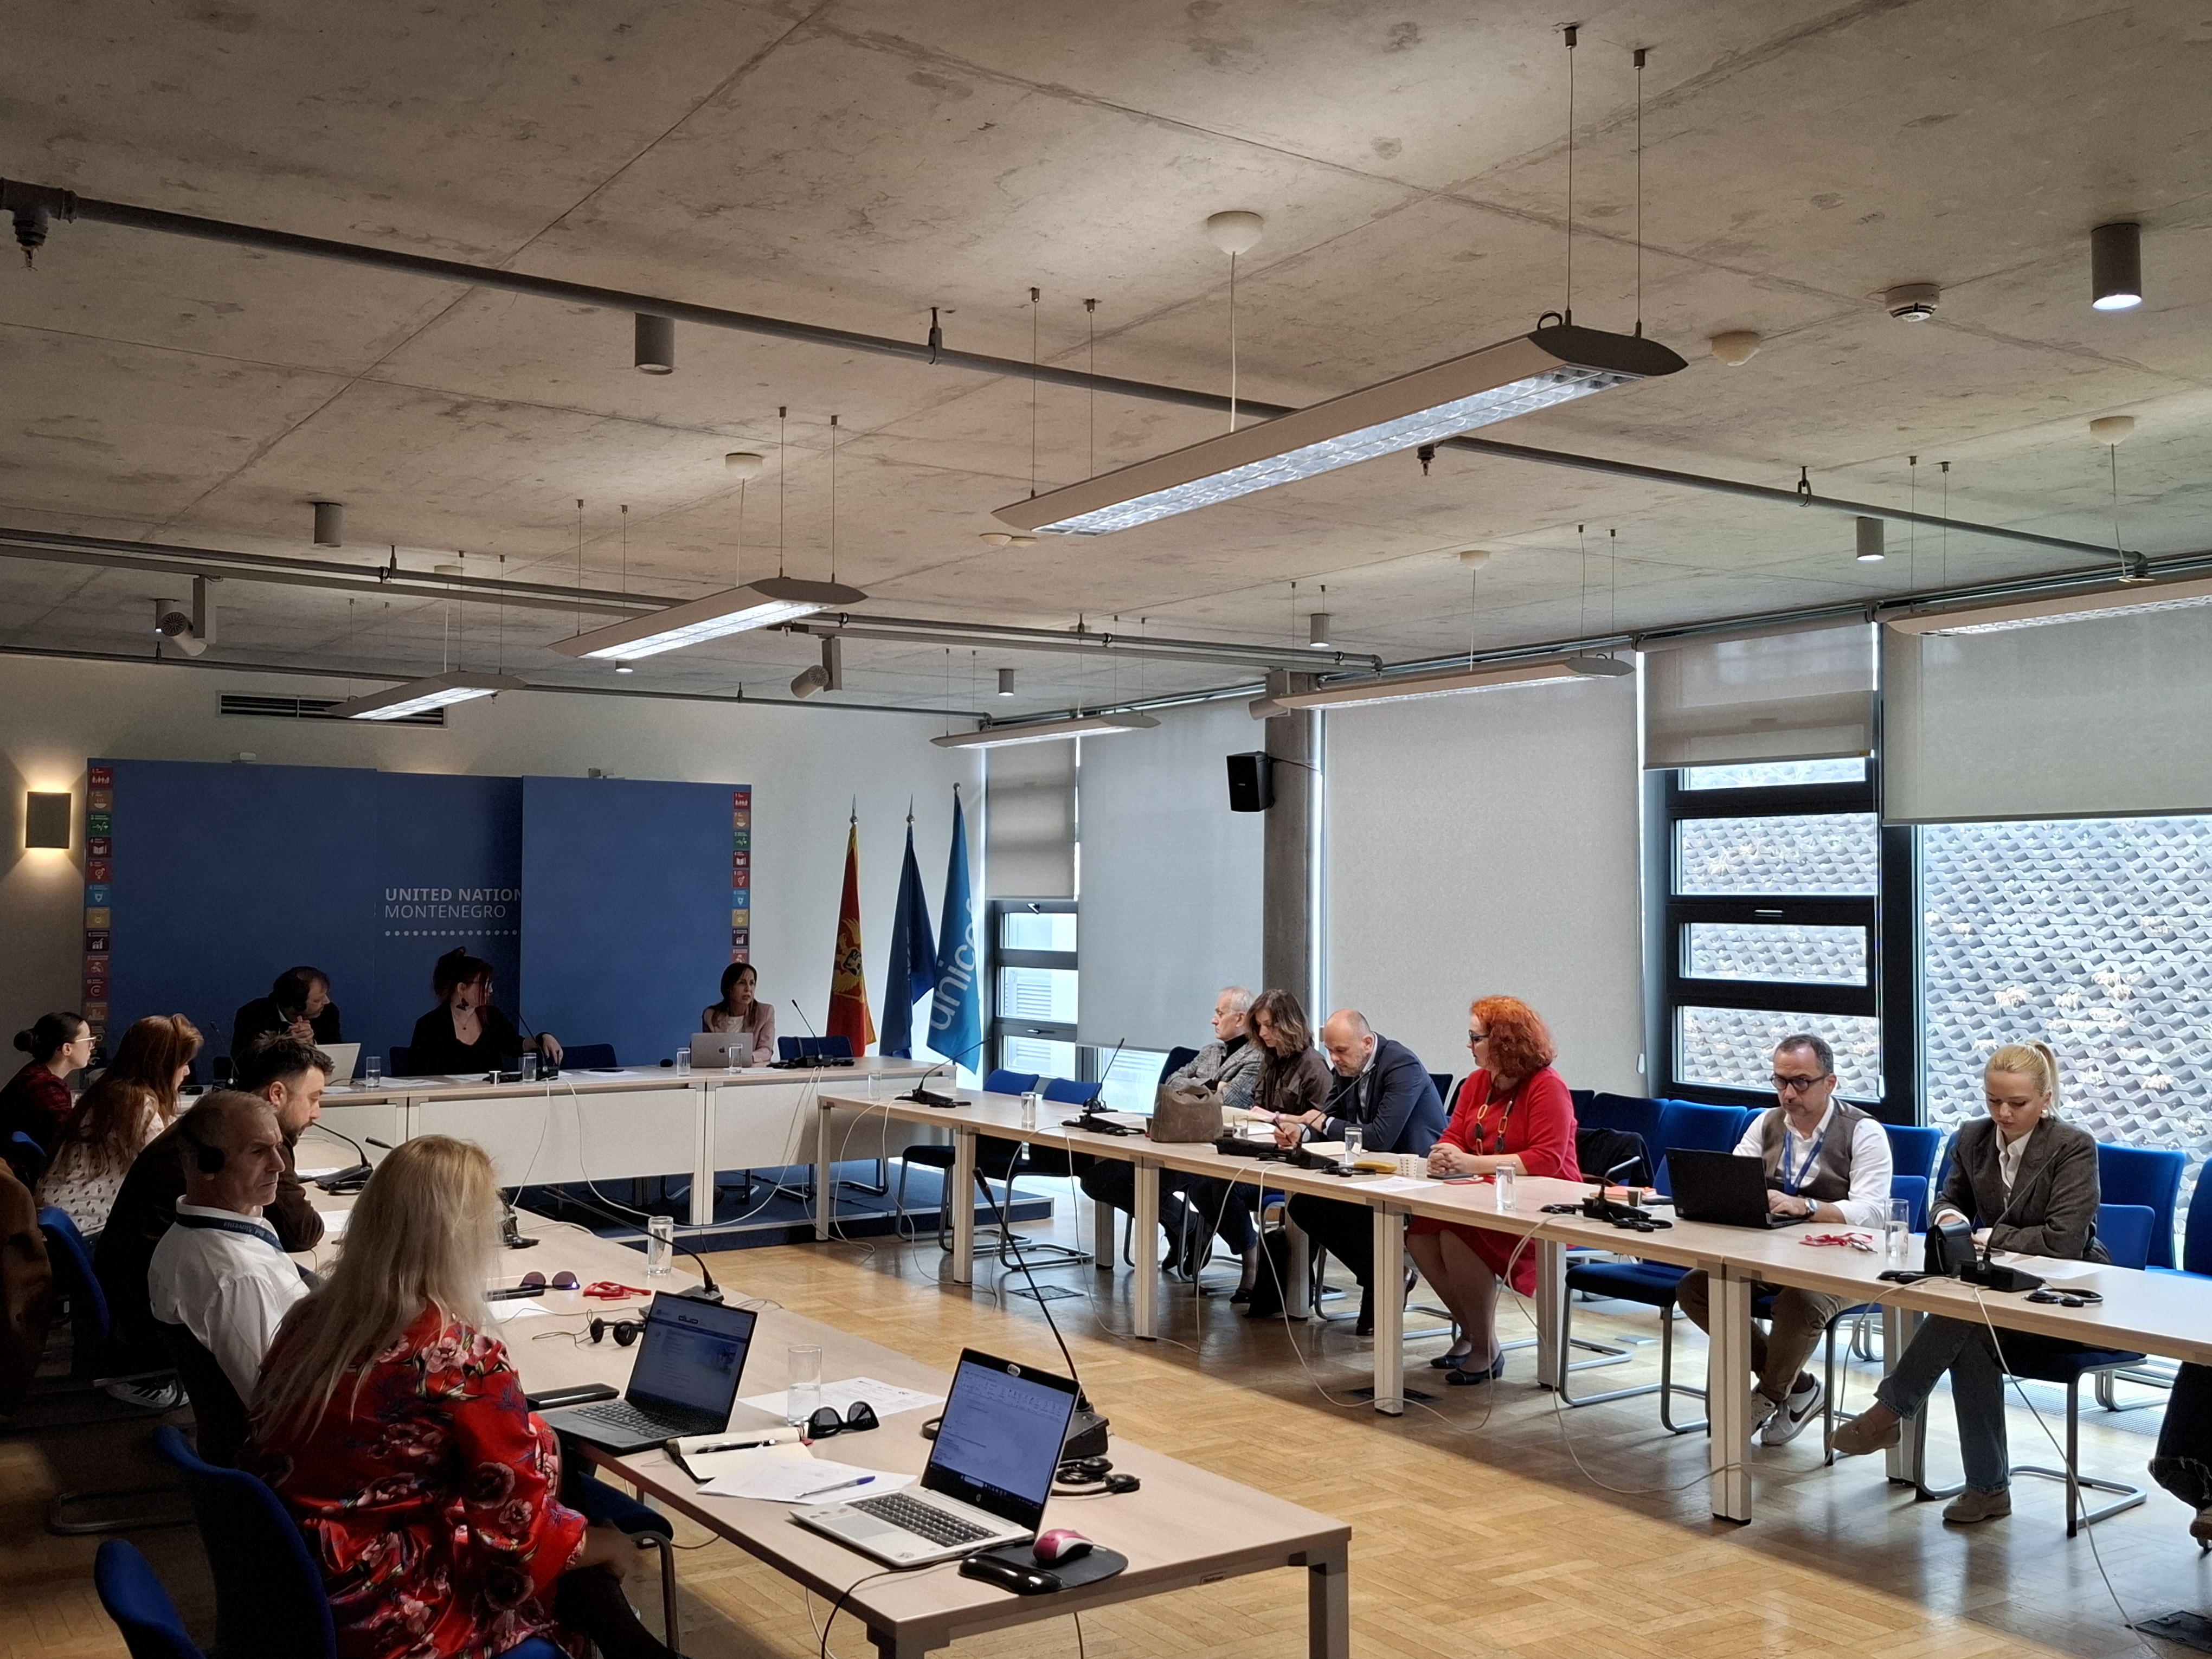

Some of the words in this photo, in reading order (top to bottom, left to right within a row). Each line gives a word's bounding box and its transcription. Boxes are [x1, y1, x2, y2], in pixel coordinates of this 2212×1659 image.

[385, 888, 452, 902] UNITED
[385, 904, 506, 918] MONTENEGRO
[929, 898, 976, 1031] unice
